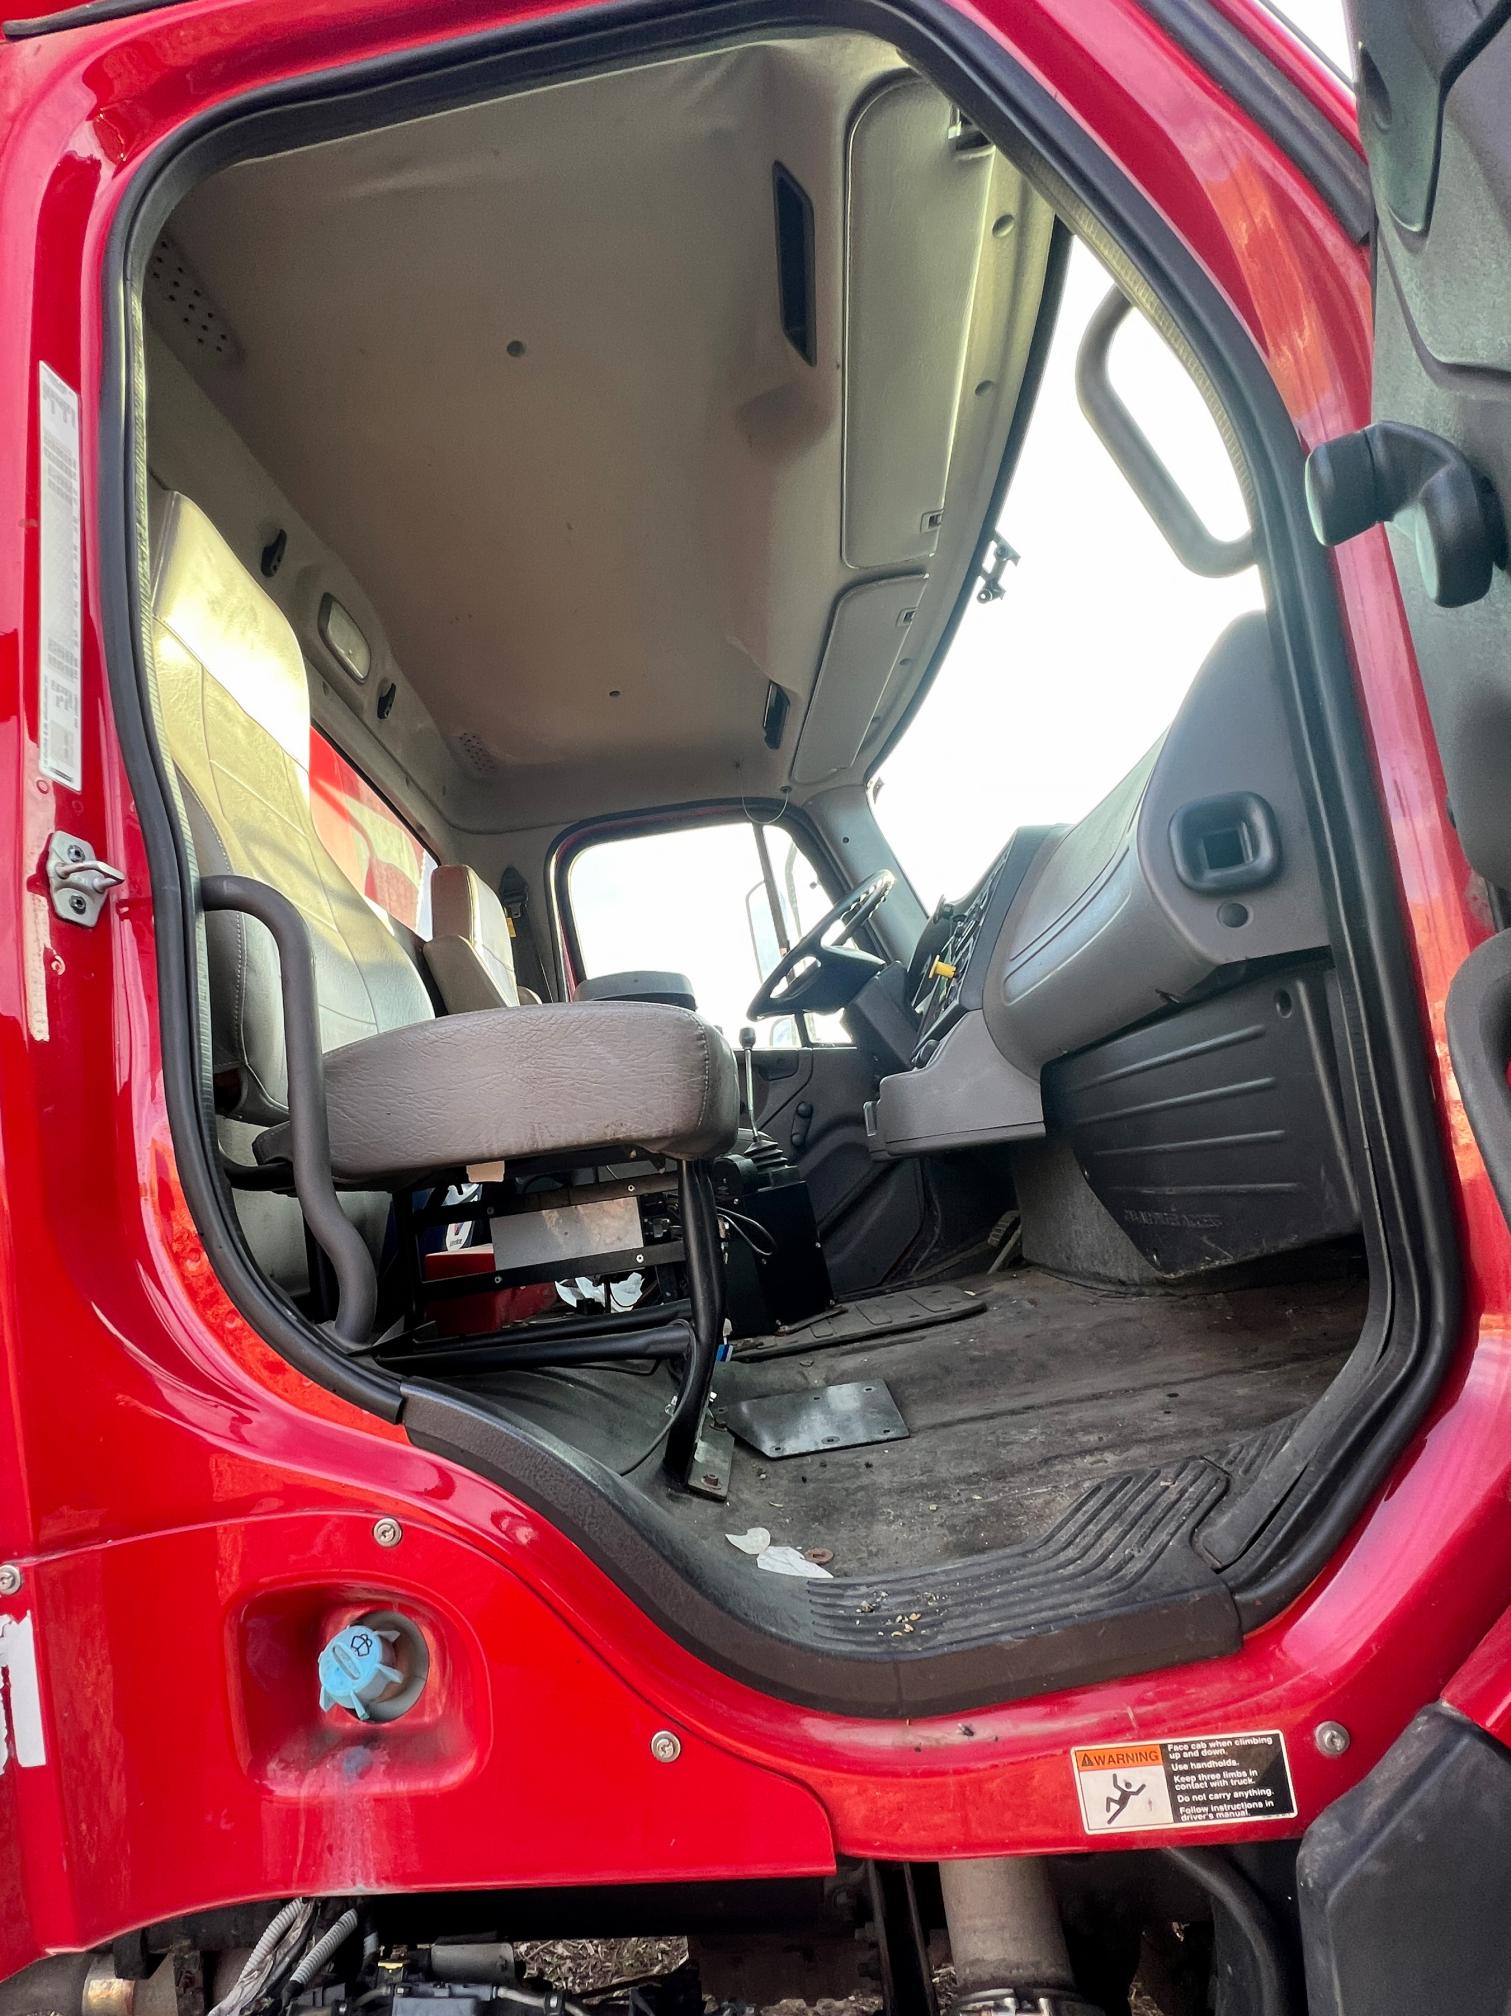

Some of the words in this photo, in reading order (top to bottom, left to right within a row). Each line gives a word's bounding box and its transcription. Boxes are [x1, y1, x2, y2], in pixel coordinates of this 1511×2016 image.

[1168, 1743, 1189, 1752] Face
[1191, 1741, 1207, 1750] cab
[1209, 1740, 1233, 1748] when
[1235, 1737, 1272, 1746] climbing
[1093, 1750, 1159, 1765] WARNING
[1169, 1752, 1181, 1760] up
[1183, 1750, 1199, 1758] and
[1171, 1763, 1189, 1771] Use
[1190, 1759, 1239, 1769] handholds.
[1174, 1774, 1197, 1784] Keep
[1198, 1772, 1221, 1781] three
[1223, 1771, 1248, 1779] limbs
[1249, 1769, 1257, 1777] in
[1175, 1781, 1208, 1791] contact
[1210, 1780, 1228, 1788] with
[1230, 1778, 1255, 1786] truck.
[1191, 1793, 1207, 1801] not
[1209, 1792, 1232, 1801] carry
[1233, 1788, 1274, 1798] anything.
[1180, 1806, 1209, 1815] Follow
[1210, 1802, 1263, 1812] instructions
[1181, 1813, 1214, 1822] driver's
